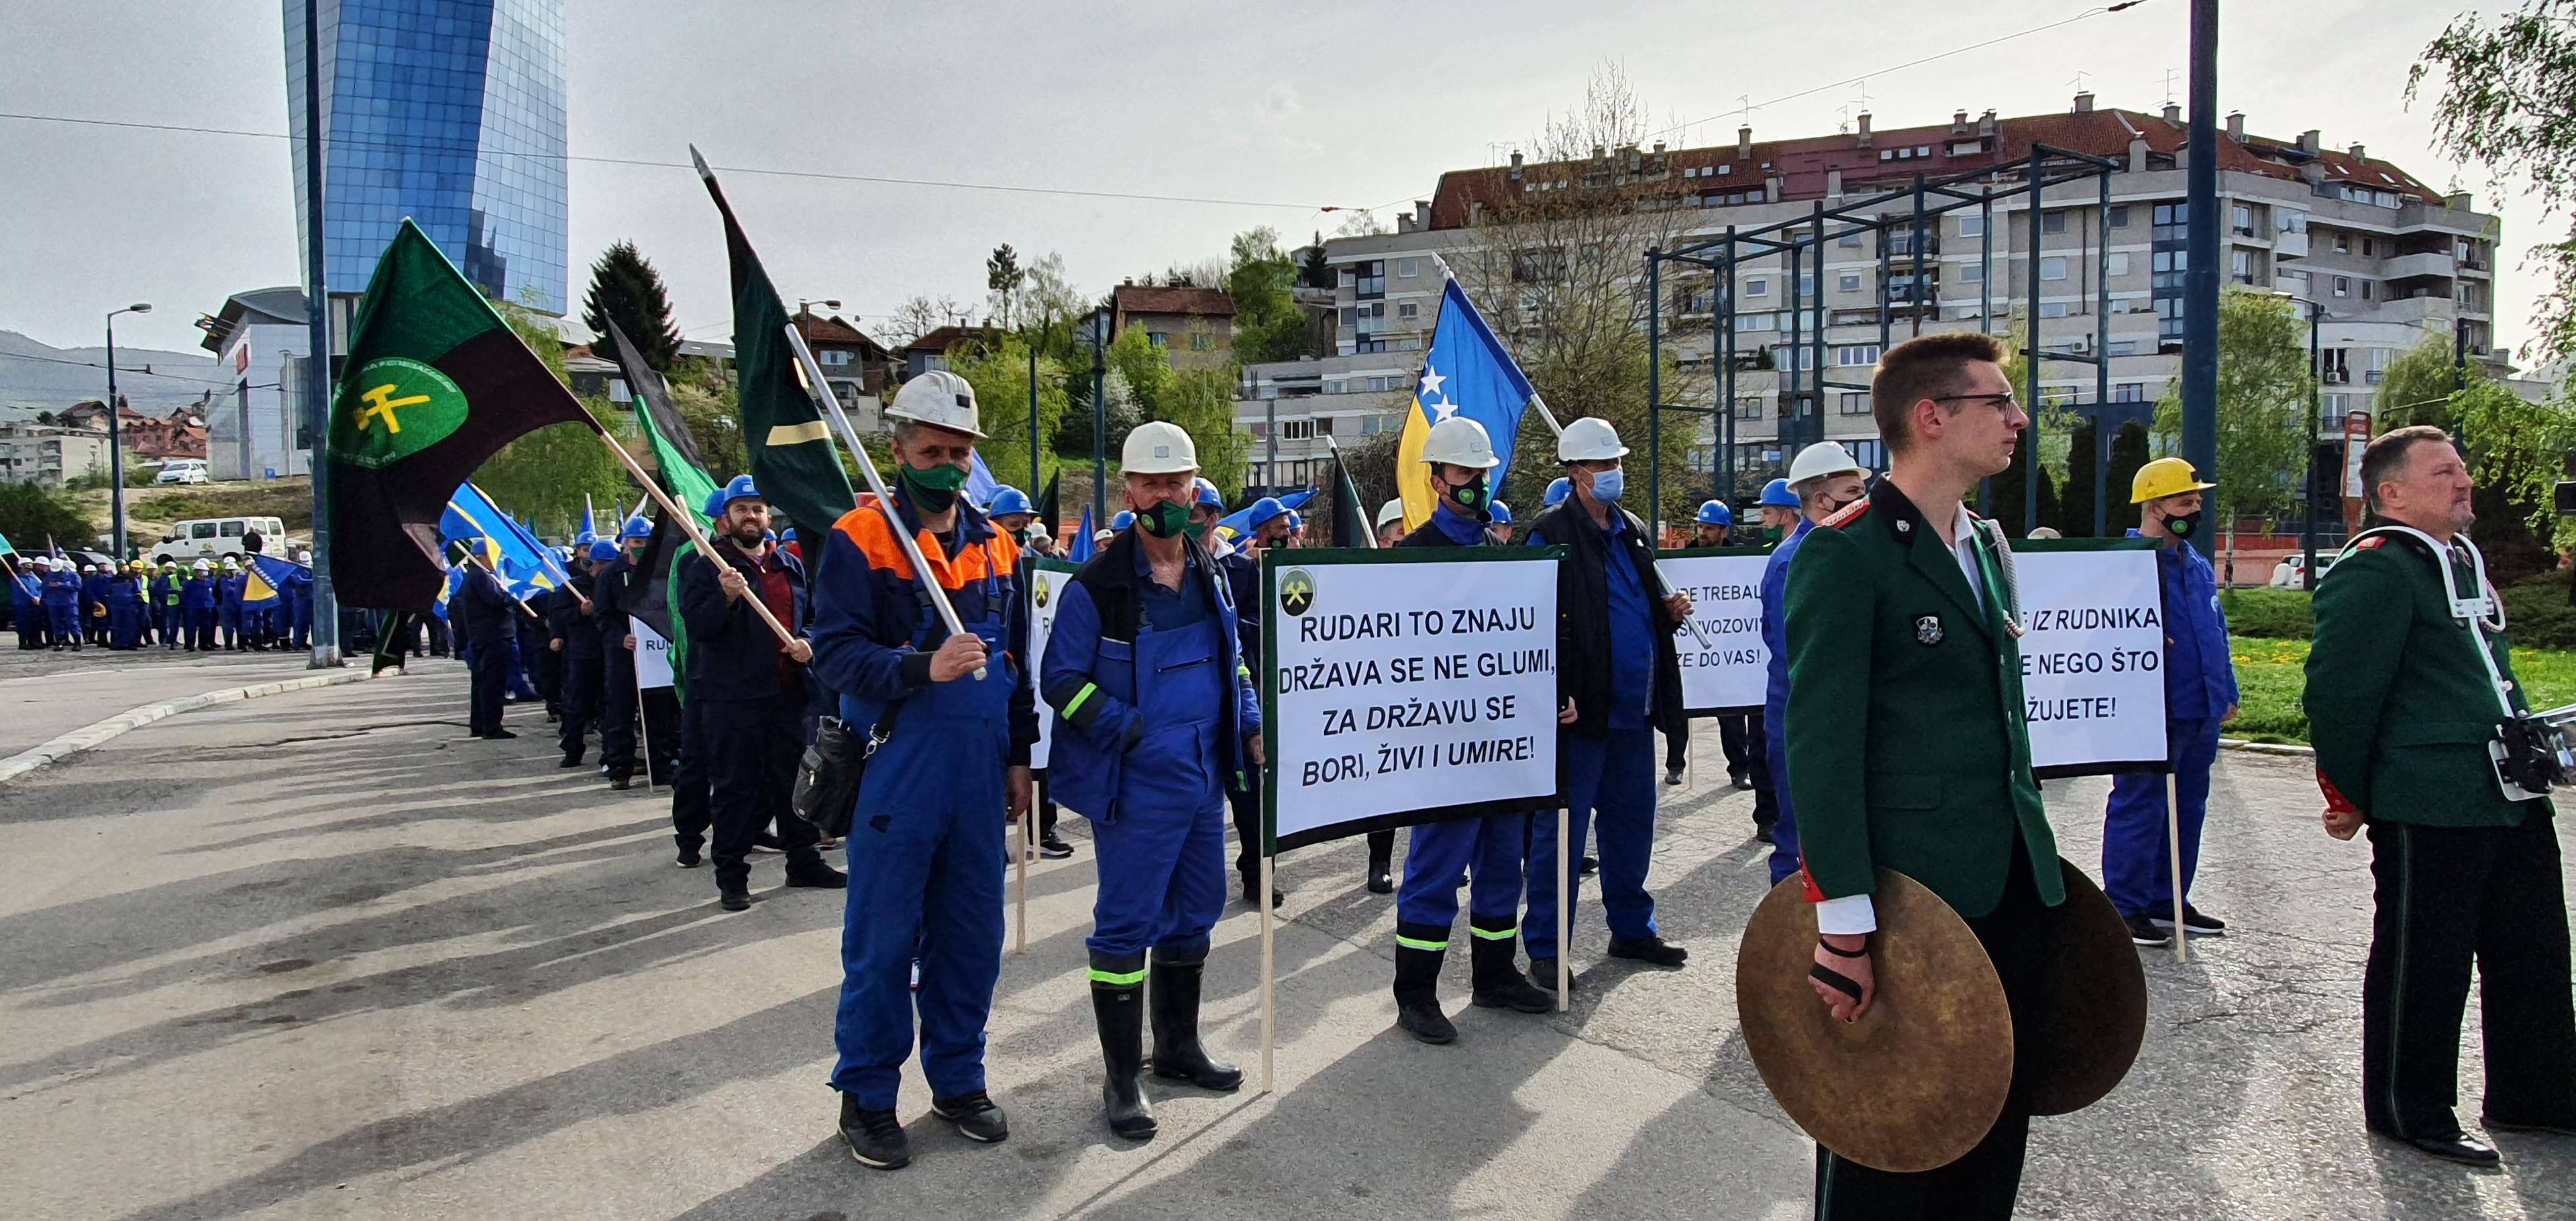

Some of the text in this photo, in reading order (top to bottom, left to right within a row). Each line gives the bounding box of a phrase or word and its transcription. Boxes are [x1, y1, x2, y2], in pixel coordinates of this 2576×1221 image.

[1042, 617, 1053, 636] R
[1301, 606, 1534, 642] RUDARI TO ZNAJU
[2033, 610, 2051, 631] IZ
[2056, 607, 2160, 630] RUDNIKA
[1279, 649, 1555, 694] DRŽAVA SE NE GLUMI,
[1699, 652, 1720, 668] DO
[1724, 649, 1760, 665] VAS!
[2039, 652, 2103, 674] NEGO
[2111, 647, 2159, 672] ŠTO
[1323, 695, 1515, 736] ZA DRŽAVU SE
[1302, 736, 1534, 786] BORI, ŽIVI I UMIRE!
